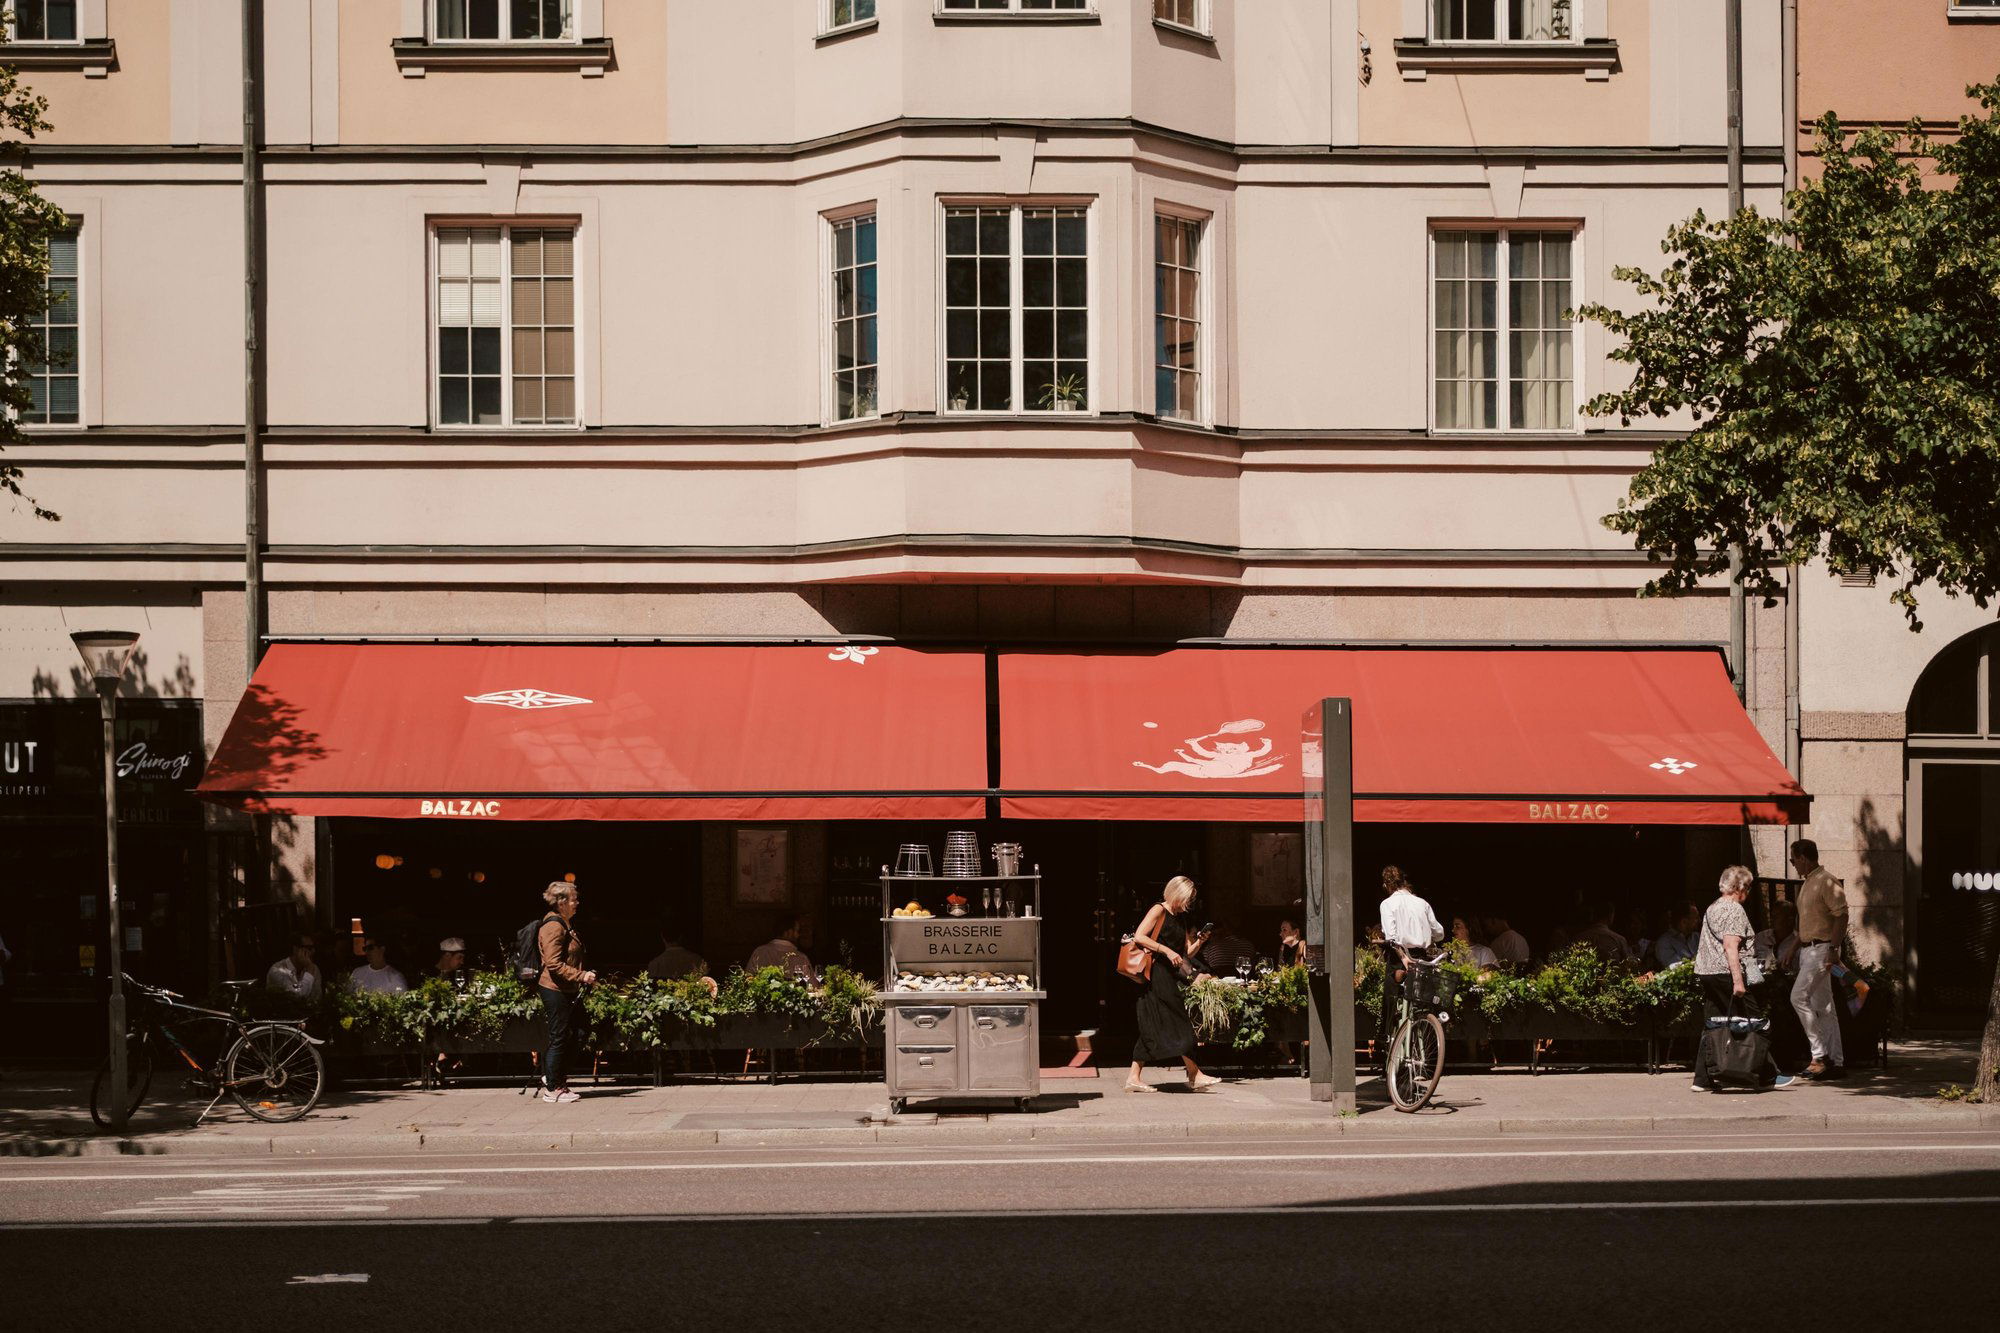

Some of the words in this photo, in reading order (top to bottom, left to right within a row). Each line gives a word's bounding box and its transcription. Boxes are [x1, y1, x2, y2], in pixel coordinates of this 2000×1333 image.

[4, 741, 38, 774] UT
[115, 742, 192, 780] Shinogi
[420, 800, 501, 816] BALZAC
[1529, 803, 1609, 820] BALZAC
[924, 925, 1002, 937] BRASSERIE
[929, 943, 998, 955] BALZAC
